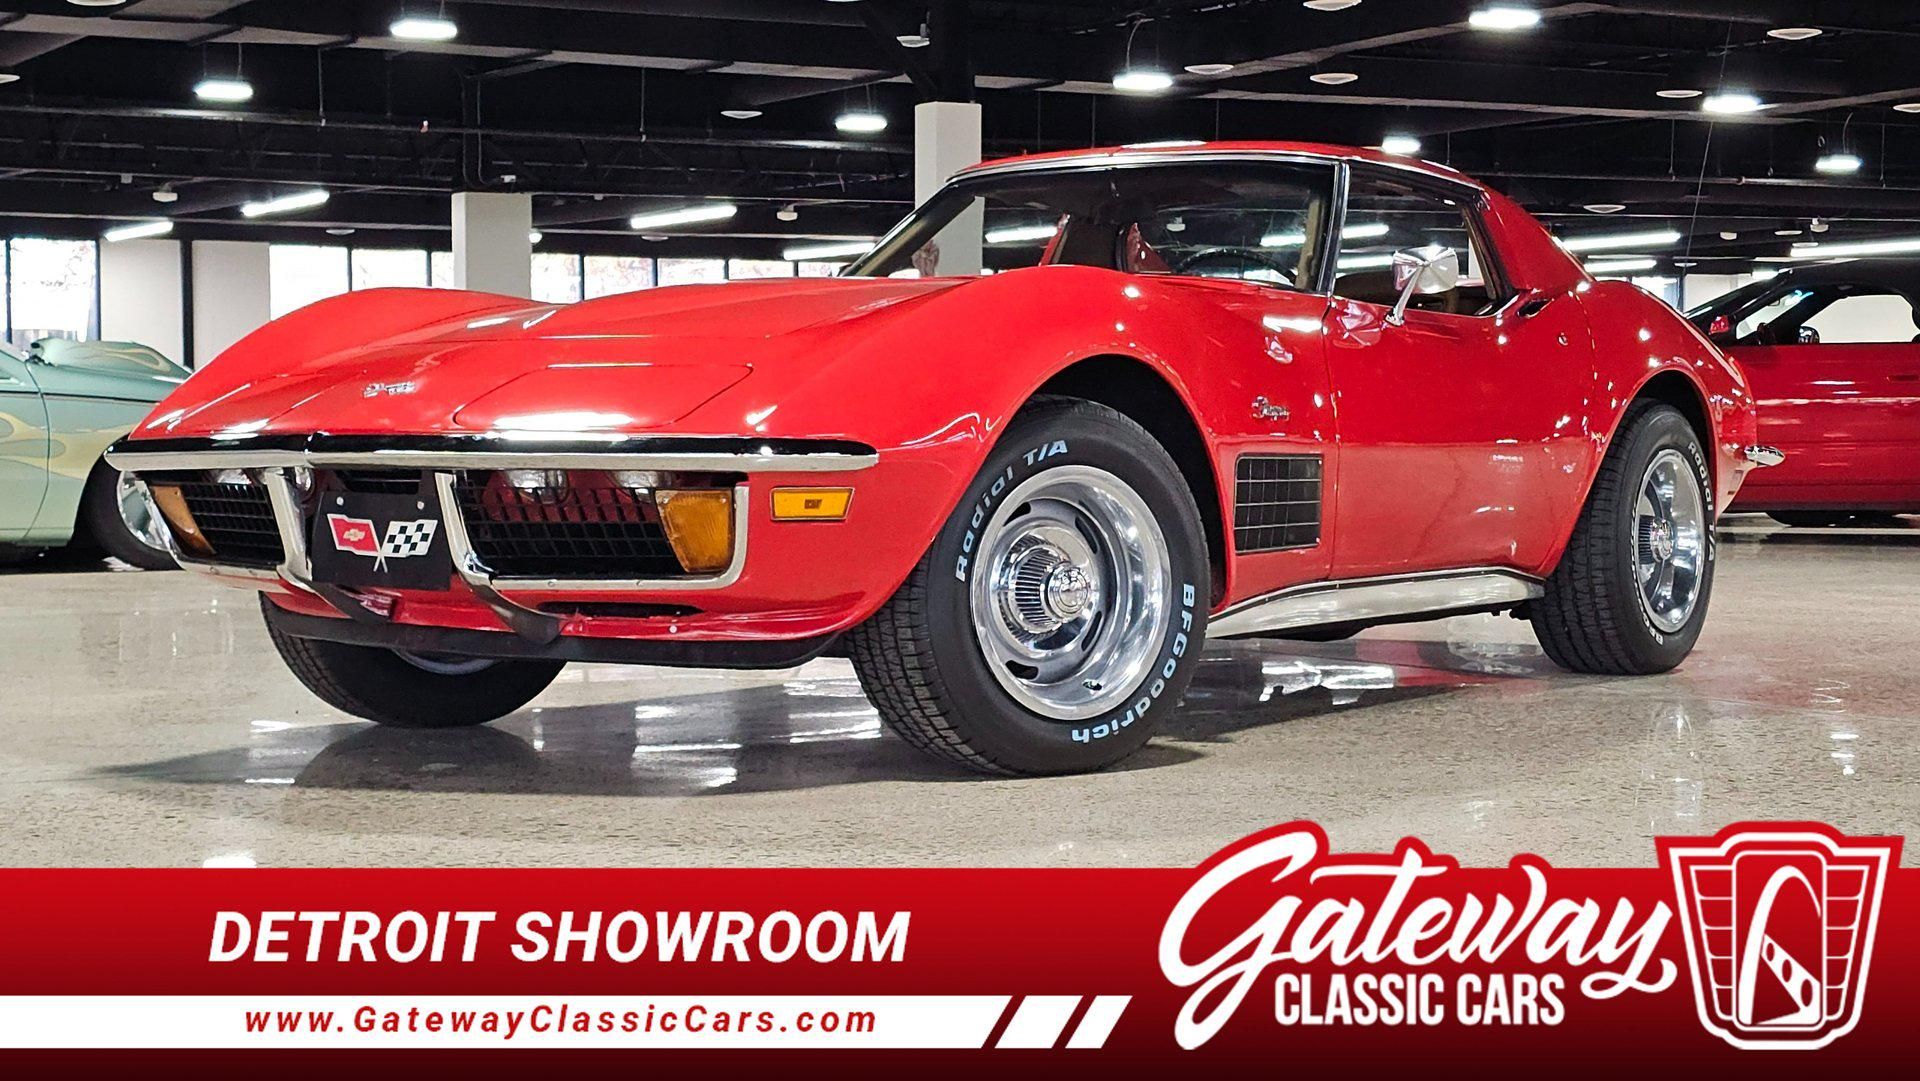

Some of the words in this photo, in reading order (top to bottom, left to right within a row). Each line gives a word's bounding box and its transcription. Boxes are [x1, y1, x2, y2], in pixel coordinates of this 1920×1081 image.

[955, 464, 1014, 582] Radial
[1023, 439, 1069, 467] T/A
[1072, 583, 1197, 744] BFGoodrich
